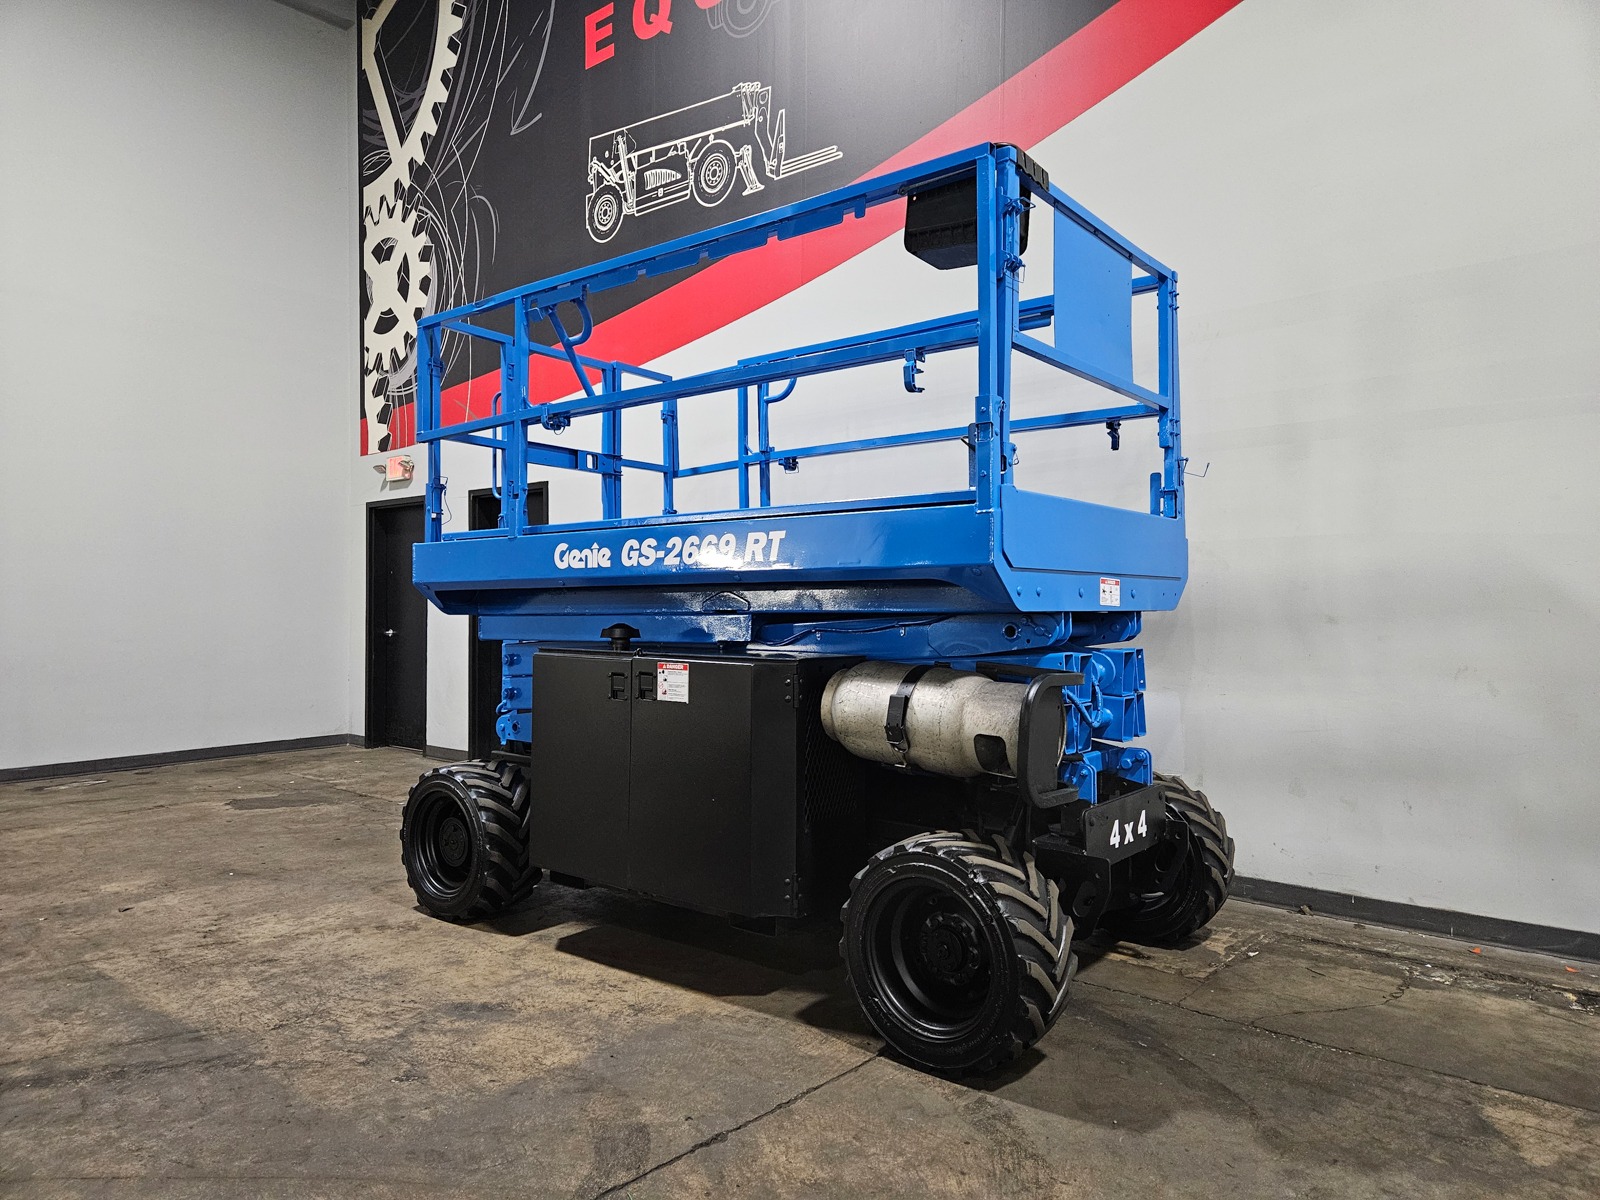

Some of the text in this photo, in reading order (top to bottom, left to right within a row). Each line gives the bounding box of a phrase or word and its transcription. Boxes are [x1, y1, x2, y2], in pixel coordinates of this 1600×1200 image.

[585, 0, 722, 70] EQ
[554, 530, 786, 569] Genie GS-2669 RT
